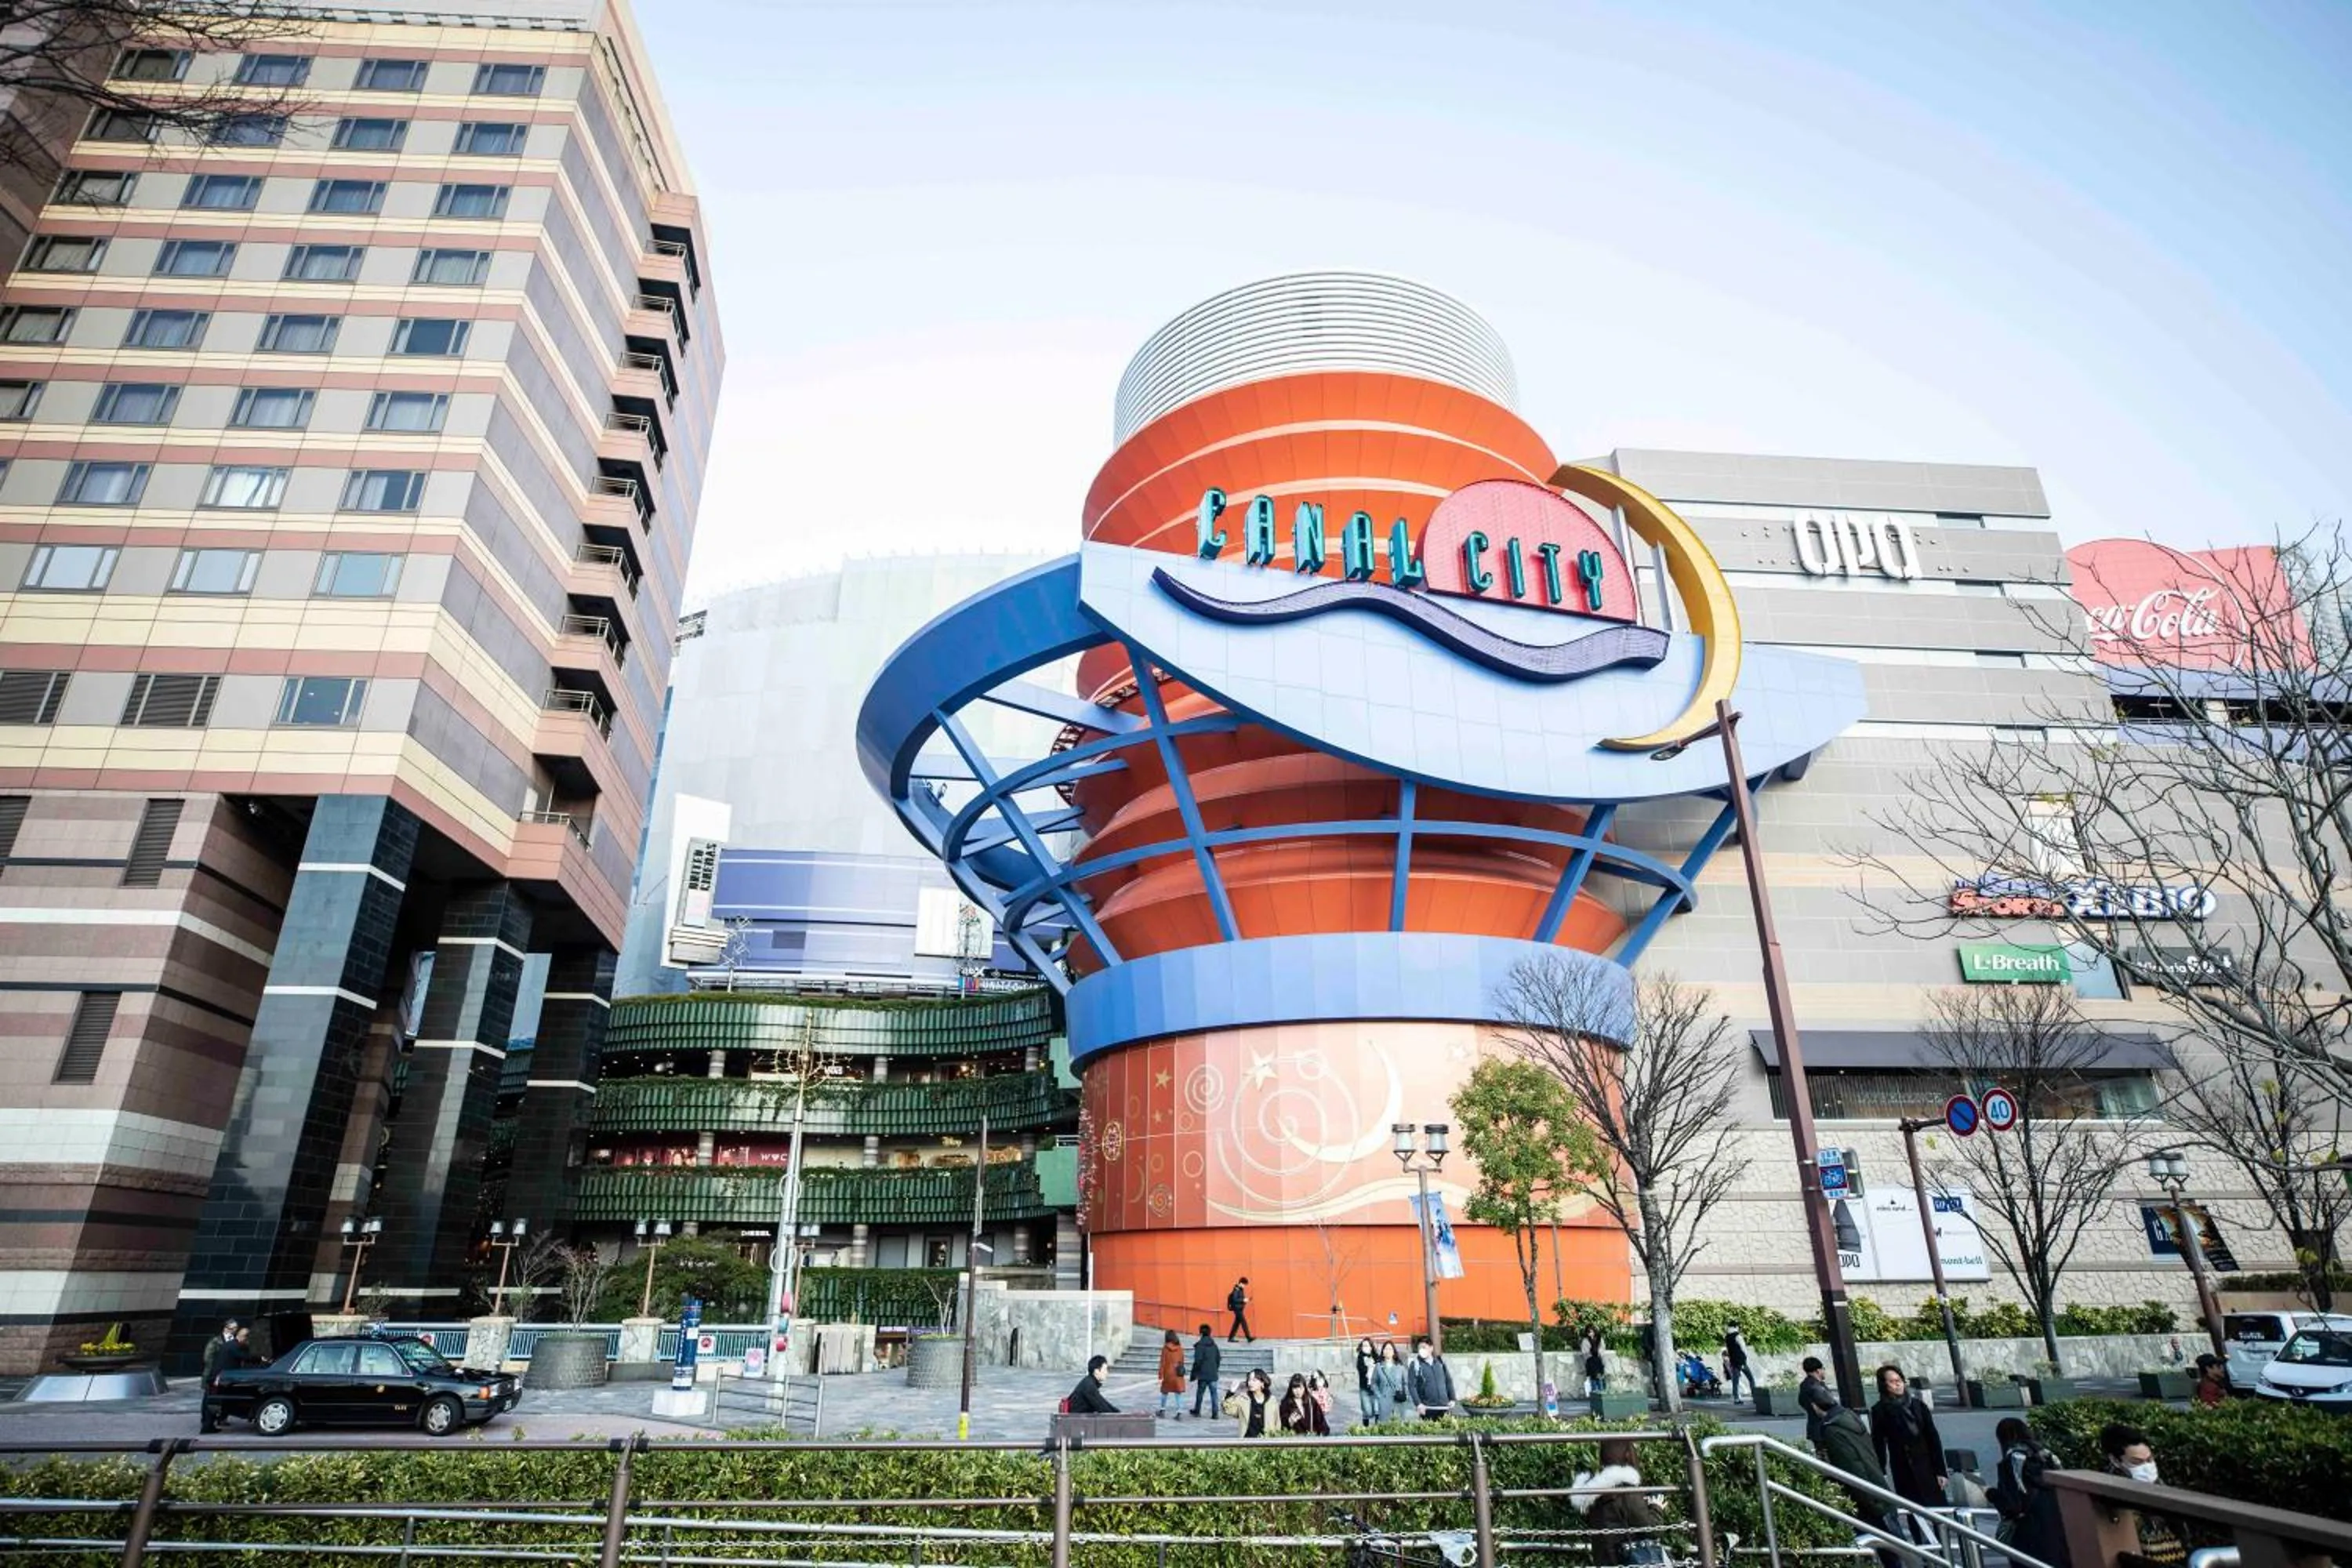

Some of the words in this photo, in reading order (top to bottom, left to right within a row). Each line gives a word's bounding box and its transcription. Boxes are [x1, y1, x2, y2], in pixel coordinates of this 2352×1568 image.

[1197, 486, 1425, 590] CANAL
[1464, 531, 1603, 612] CITY
[1991, 1100, 2009, 1120] 40
